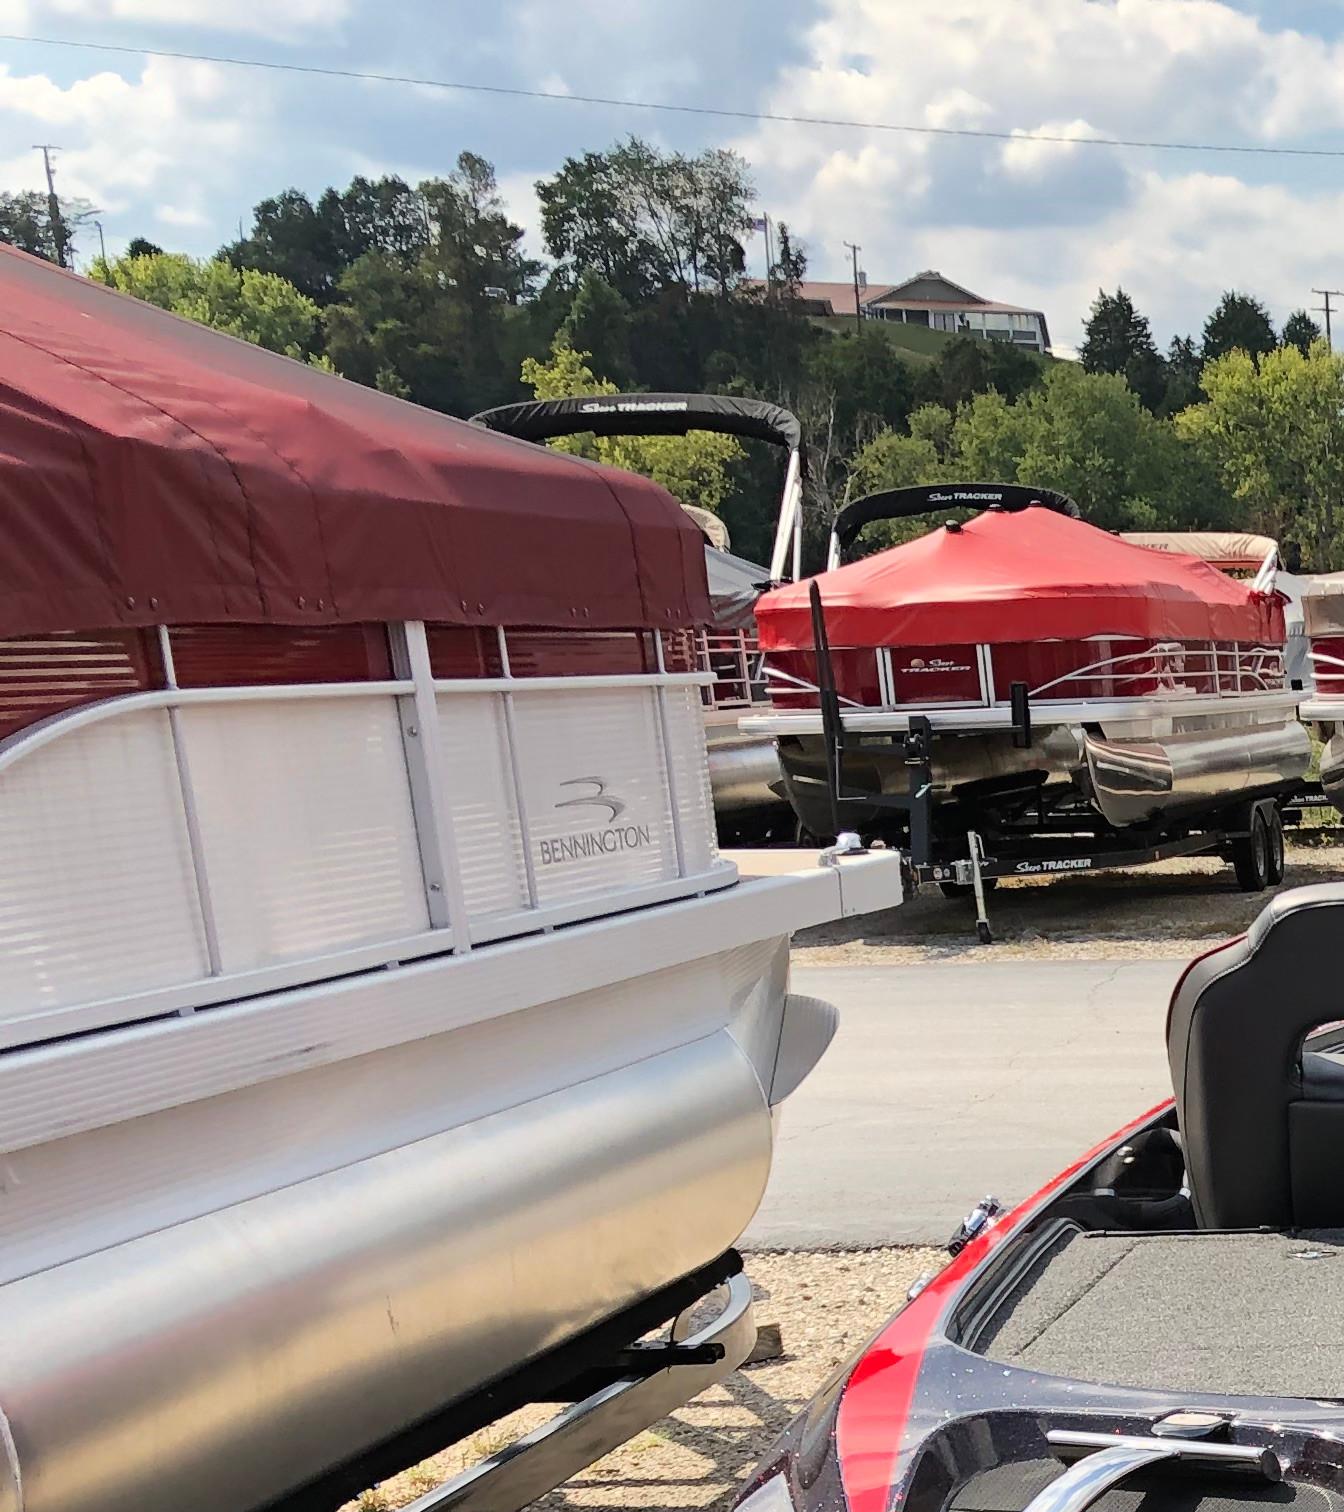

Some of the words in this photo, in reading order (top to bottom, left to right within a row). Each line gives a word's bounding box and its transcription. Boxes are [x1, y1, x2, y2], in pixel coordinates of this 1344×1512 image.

[617, 401, 688, 412] TRACKER
[953, 492, 1003, 501] TRACKER
[540, 824, 651, 865] BENNINGTON
[1042, 858, 1092, 871] TRACKER
